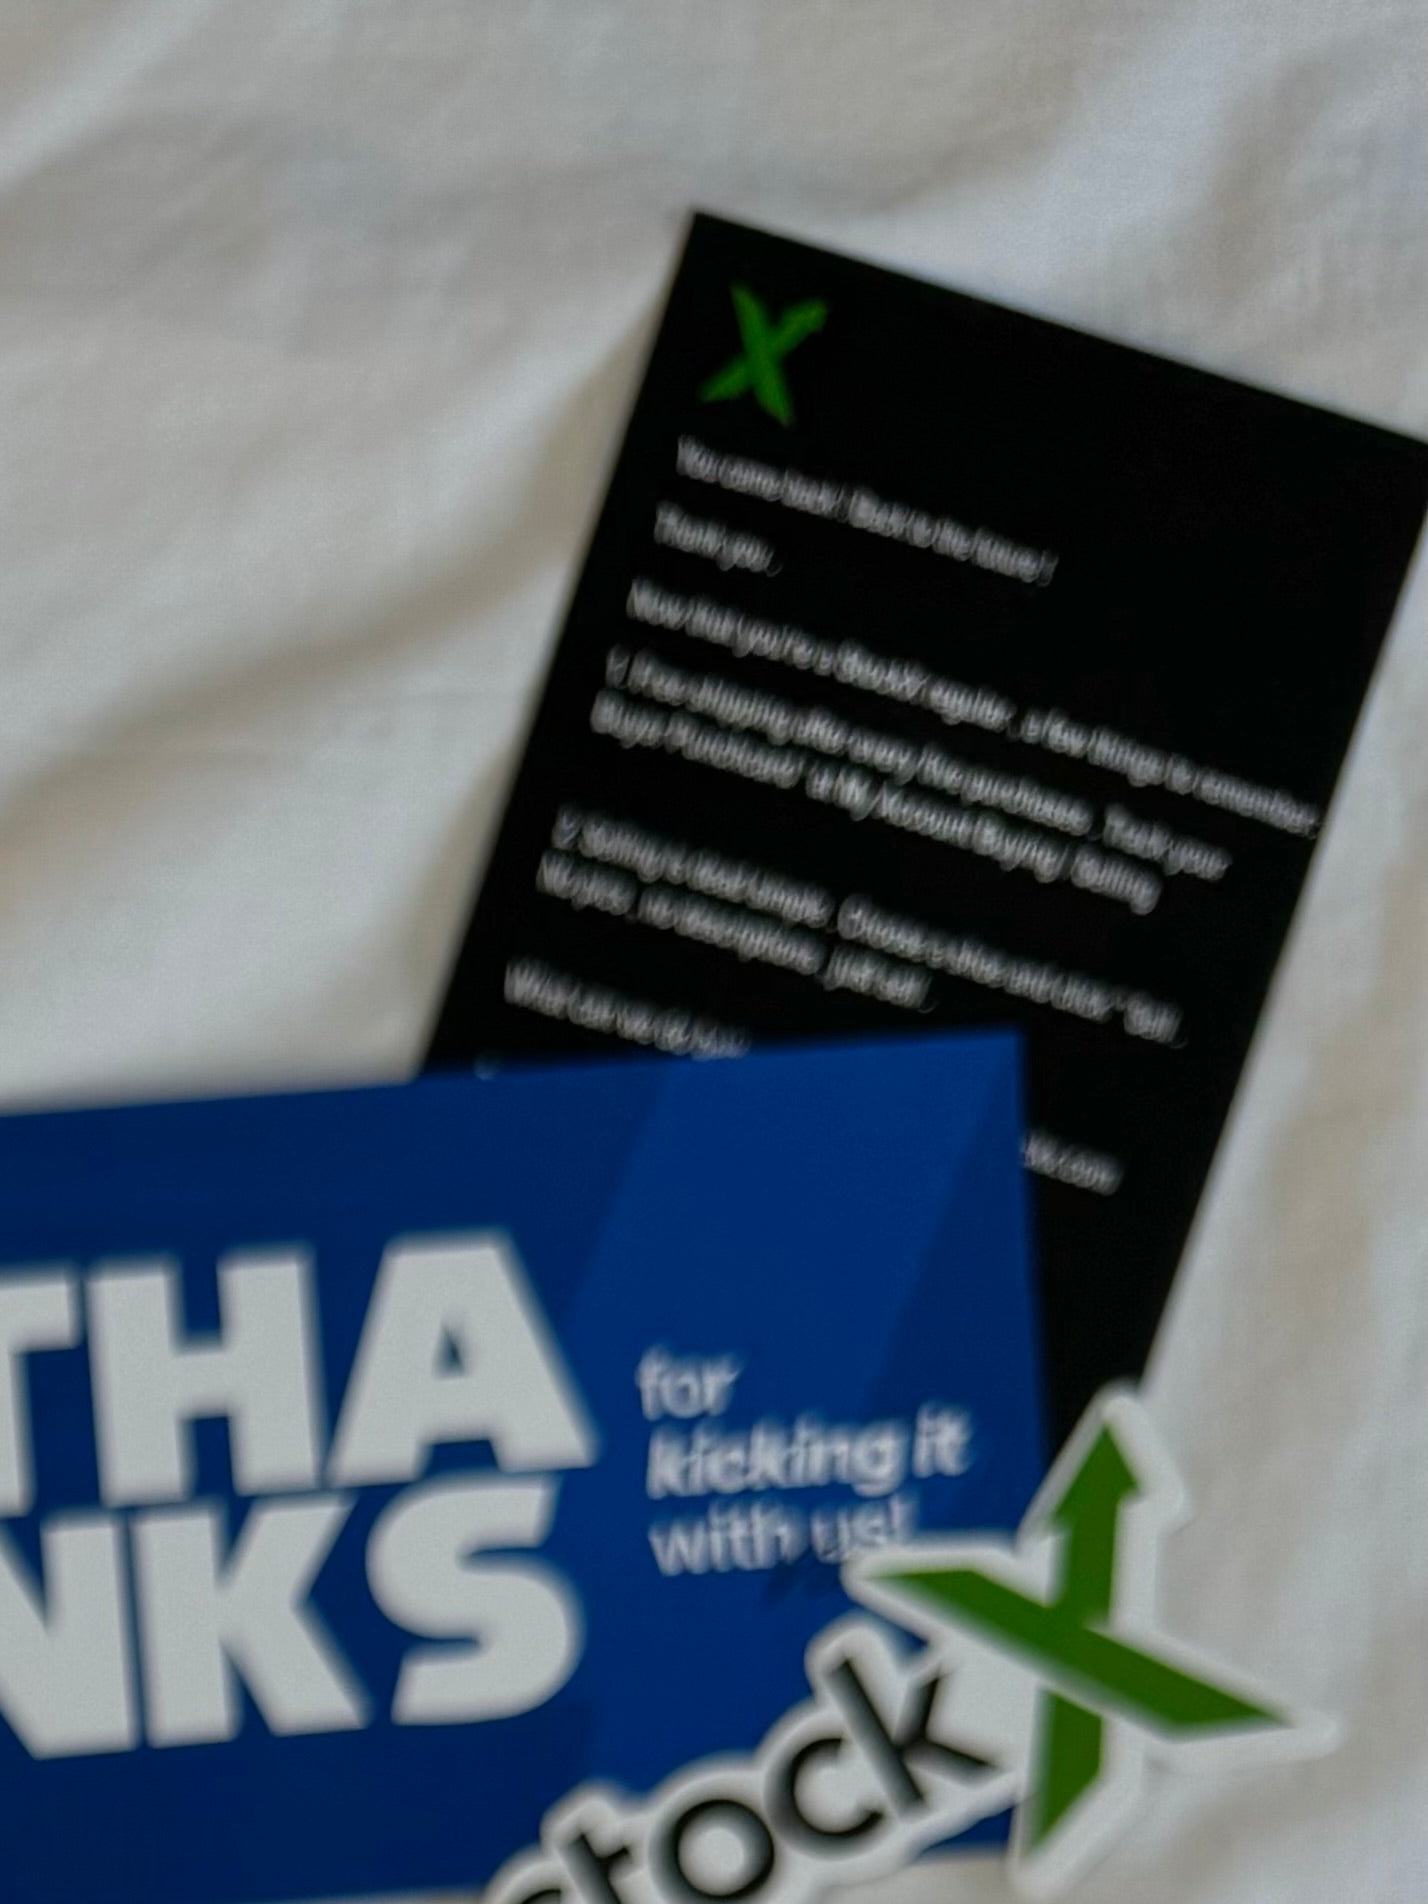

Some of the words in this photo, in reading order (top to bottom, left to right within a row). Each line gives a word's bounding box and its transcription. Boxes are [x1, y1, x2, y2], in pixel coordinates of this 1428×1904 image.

[637, 1346, 740, 1421] for
[647, 1413, 909, 1498] kicking
[912, 1402, 972, 1479] it
[649, 1499, 806, 1577] with
